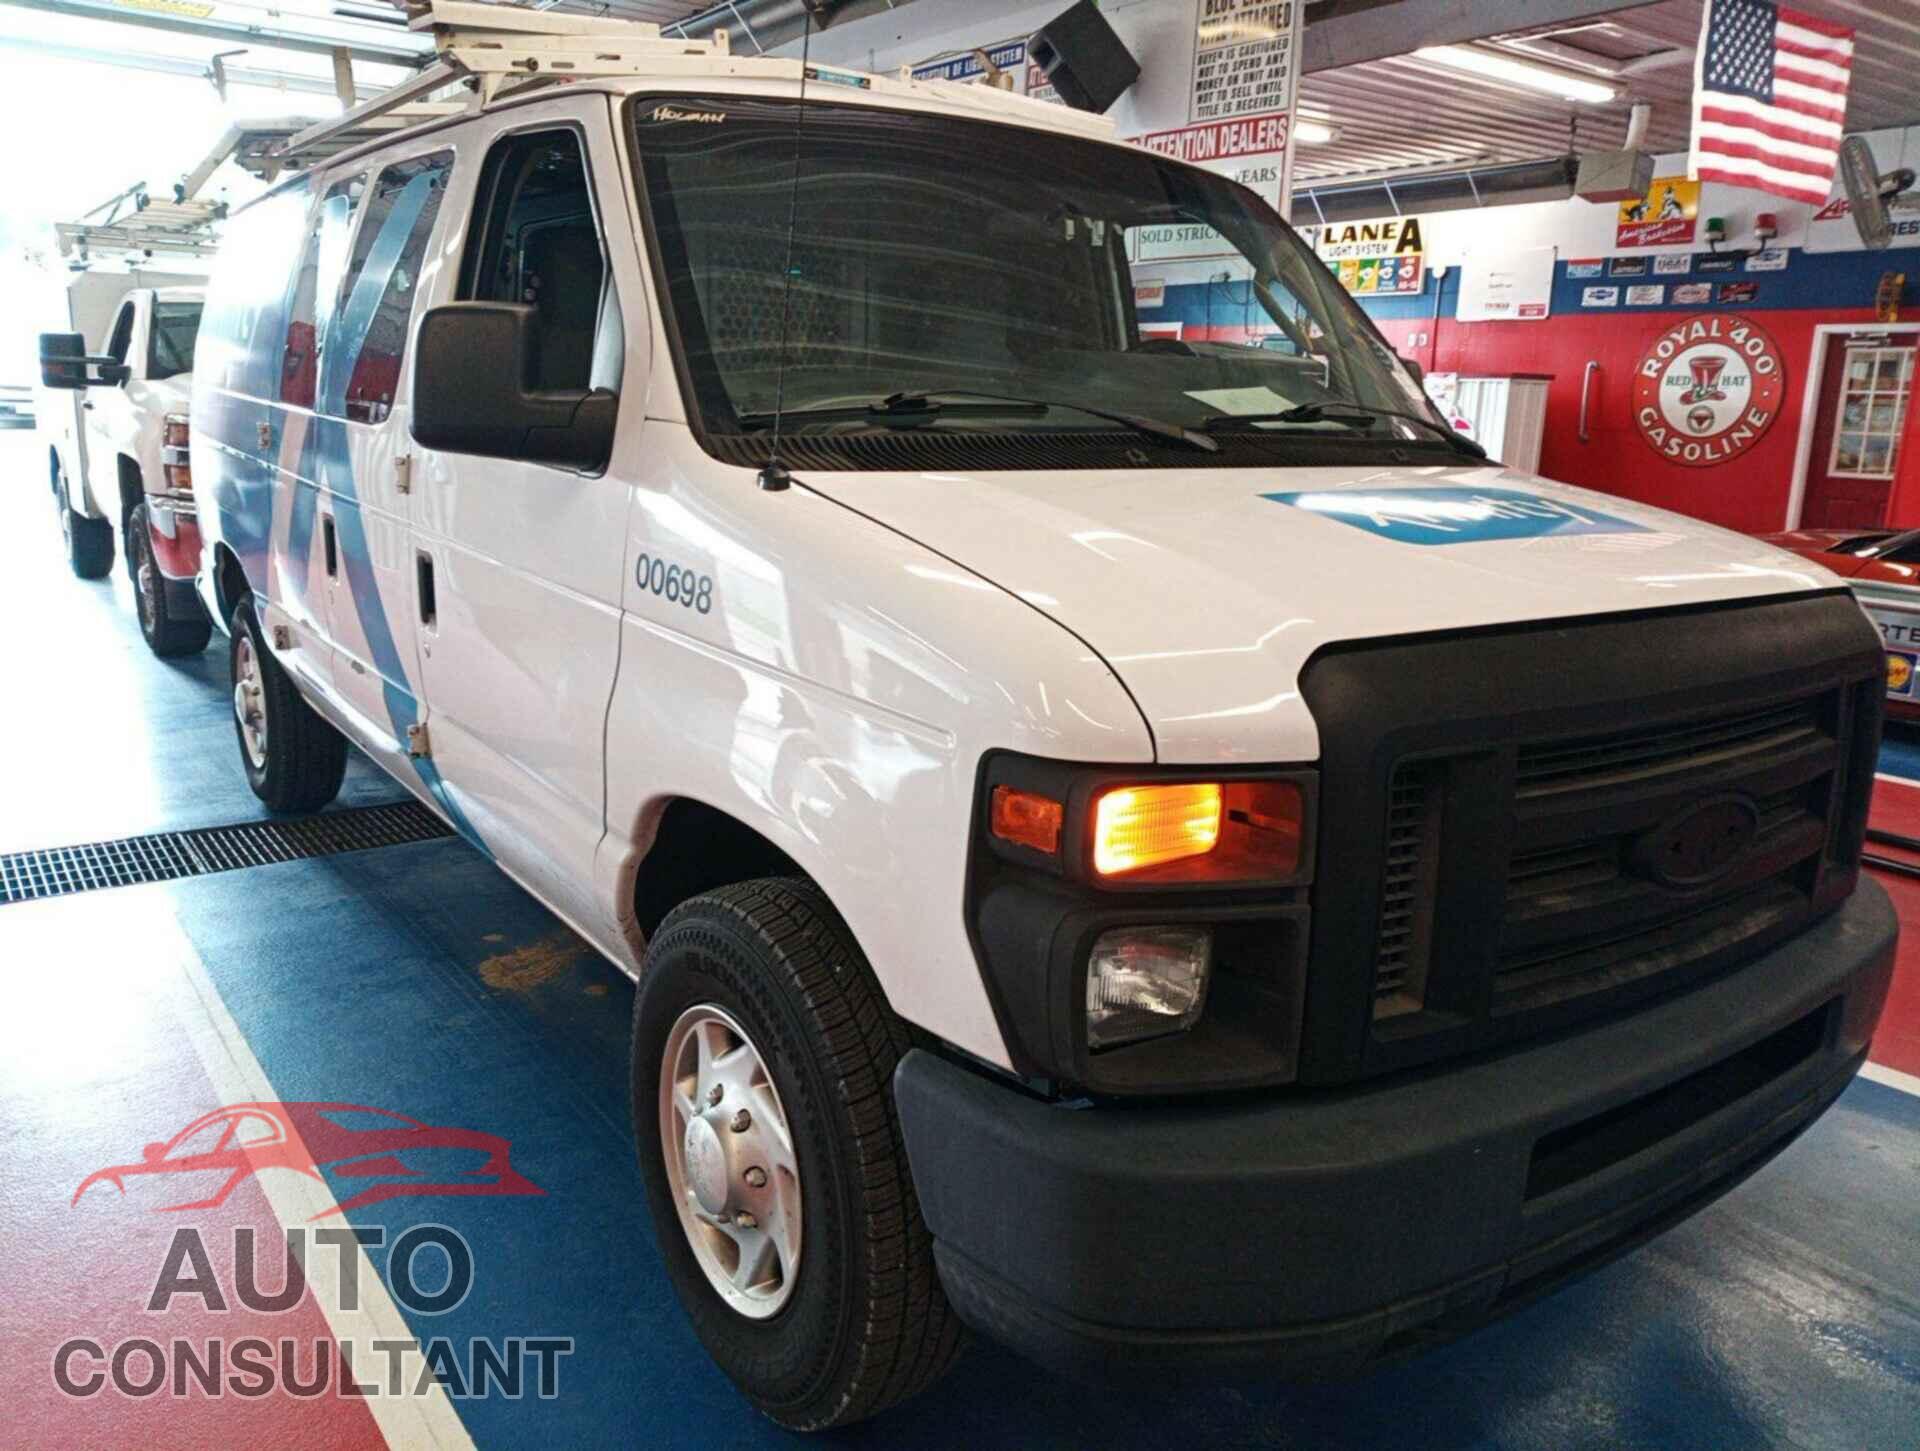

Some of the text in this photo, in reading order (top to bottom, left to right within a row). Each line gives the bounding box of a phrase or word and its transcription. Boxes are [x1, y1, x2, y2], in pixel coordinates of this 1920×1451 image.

[1226, 48, 1235, 60] IS
[1239, 37, 1289, 58] CAUTIONED
[1198, 52, 1285, 79] NOT TO SPEND ANY
[1196, 77, 1224, 92] MONEY
[1243, 70, 1265, 84] UNIT
[1267, 66, 1287, 79] AND
[1197, 80, 1282, 104] NOT TO SELL UNTIL
[1198, 94, 1281, 118] TITLE IS RECEIVED
[1219, 117, 1288, 157] DEALERS
[1141, 229, 1173, 244] SOLD
[1323, 217, 1423, 254] LANE A
[1329, 243, 1389, 257] LIGHT SYSTEM
[1641, 318, 1722, 379] ROYAL
[1665, 374, 1747, 387] RED HAT
[1639, 406, 1769, 461] GASOLINE
[636, 552, 713, 615] 00698
